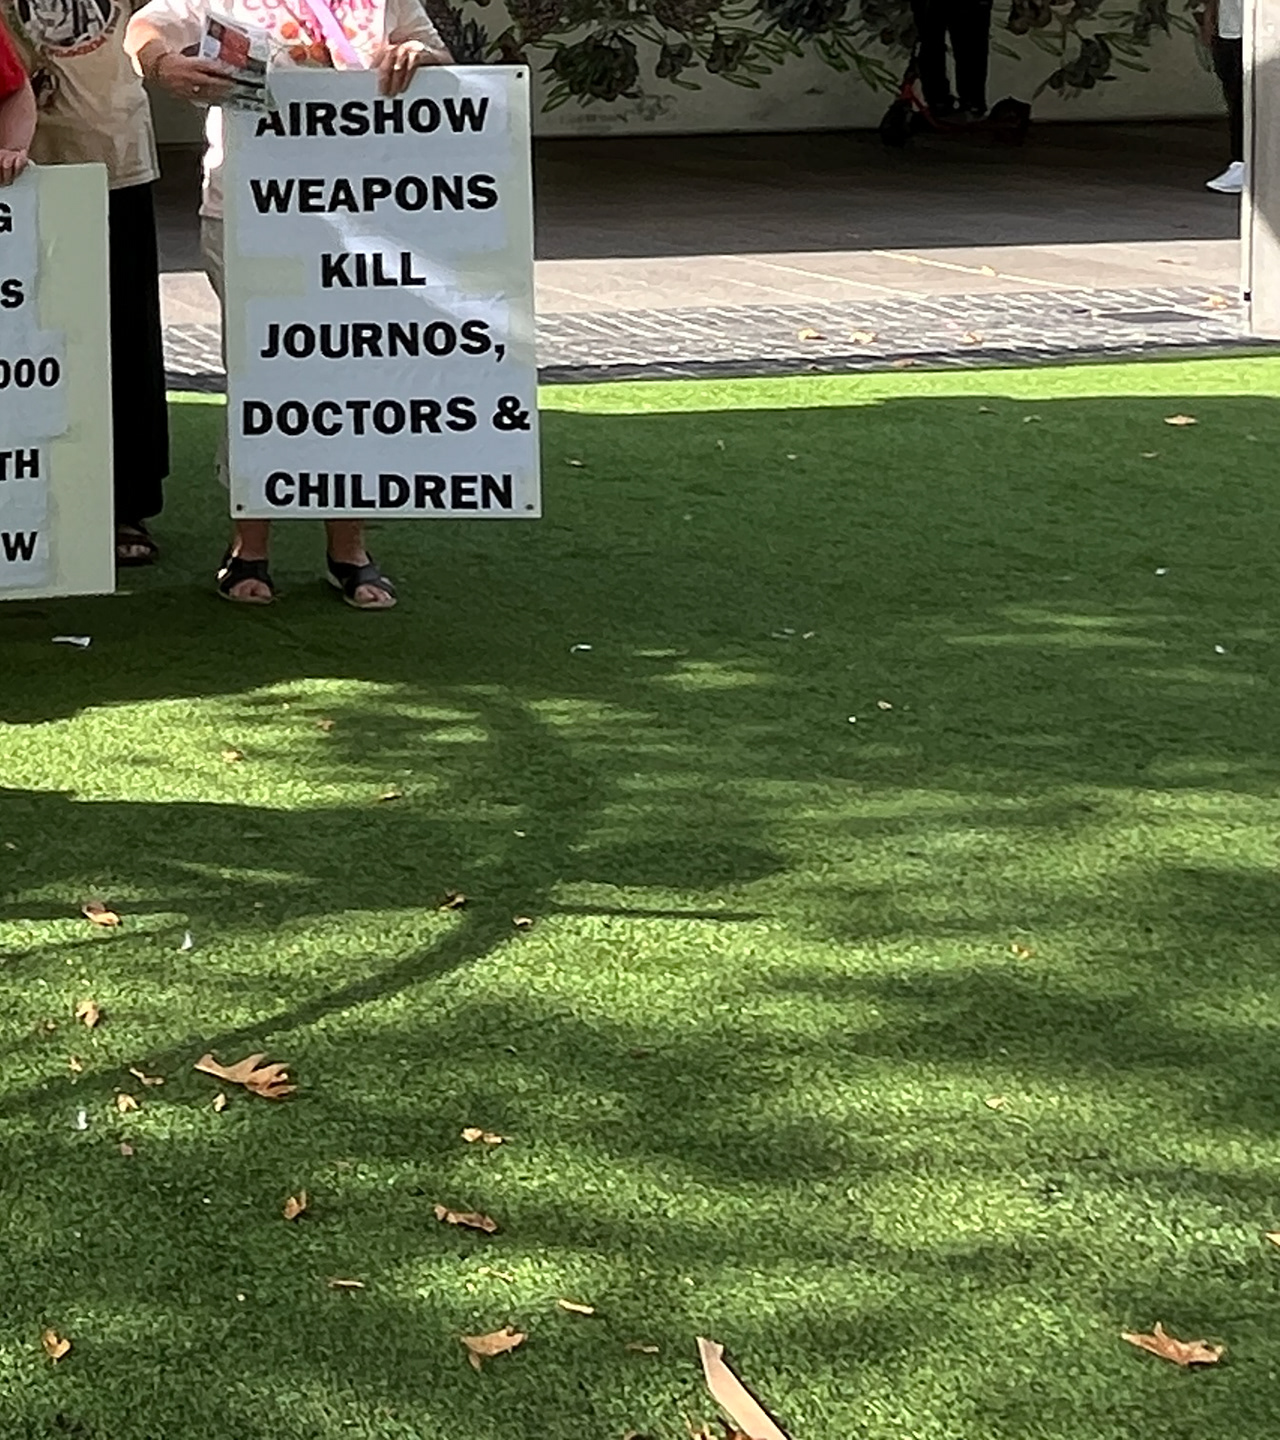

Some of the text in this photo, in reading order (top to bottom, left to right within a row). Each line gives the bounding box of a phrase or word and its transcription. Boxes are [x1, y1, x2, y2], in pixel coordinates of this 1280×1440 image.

[255, 97, 489, 137] AIRSHOW
[250, 174, 498, 214] WEAPONS
[321, 252, 426, 288] KILL
[260, 319, 506, 362] JOURNOS,
[243, 395, 531, 436] DOCTORS &
[264, 471, 513, 510] CHILDREN
